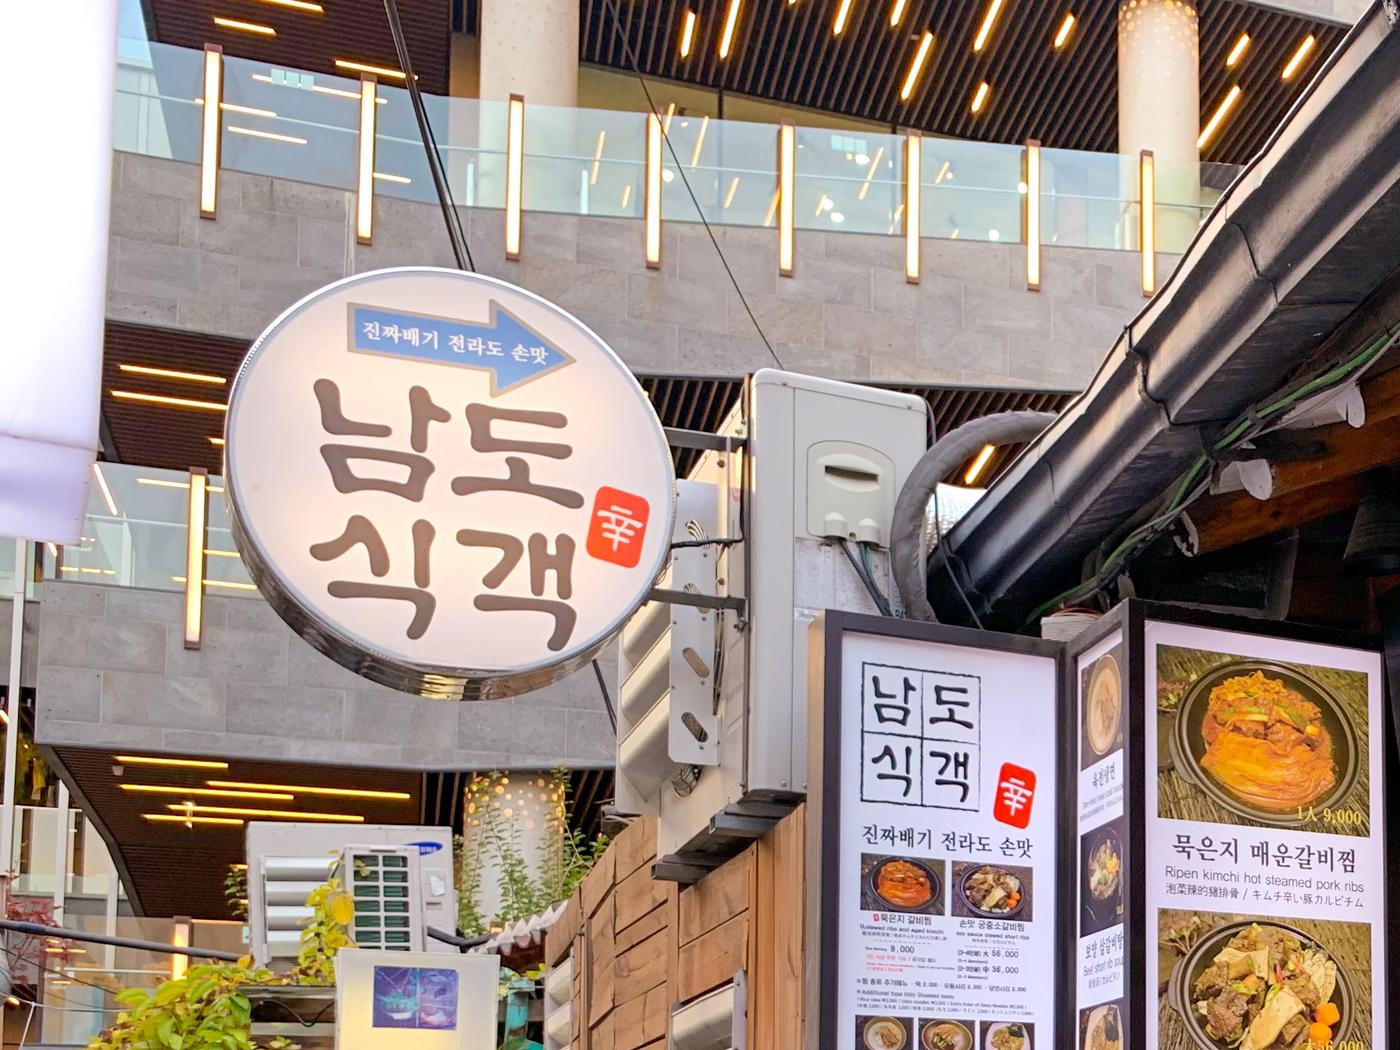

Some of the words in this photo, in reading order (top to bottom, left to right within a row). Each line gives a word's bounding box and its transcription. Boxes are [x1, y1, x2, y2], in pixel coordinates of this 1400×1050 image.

[362, 321, 439, 350] 진짜배기
[448, 334, 504, 357] 전라도
[511, 344, 548, 365] 손맛
[313, 378, 585, 509] 남도
[309, 514, 577, 652] 식객
[872, 675, 973, 729] 남도
[871, 745, 969, 802] 식객
[862, 824, 931, 849] 진짜배기
[941, 832, 992, 853] 전라도
[999, 837, 1033, 859] 손맛
[1172, 833, 1239, 864] 묵은지
[1250, 841, 1355, 874] 매운갈비찜
[1165, 865, 1198, 880] Ripen
[1203, 868, 1240, 883] kimchi
[1244, 872, 1261, 884] hot
[1266, 875, 1312, 889] steamed
[1316, 879, 1340, 892] pork
[1344, 882, 1364, 893] ribs
[960, 920, 975, 928] 손맛
